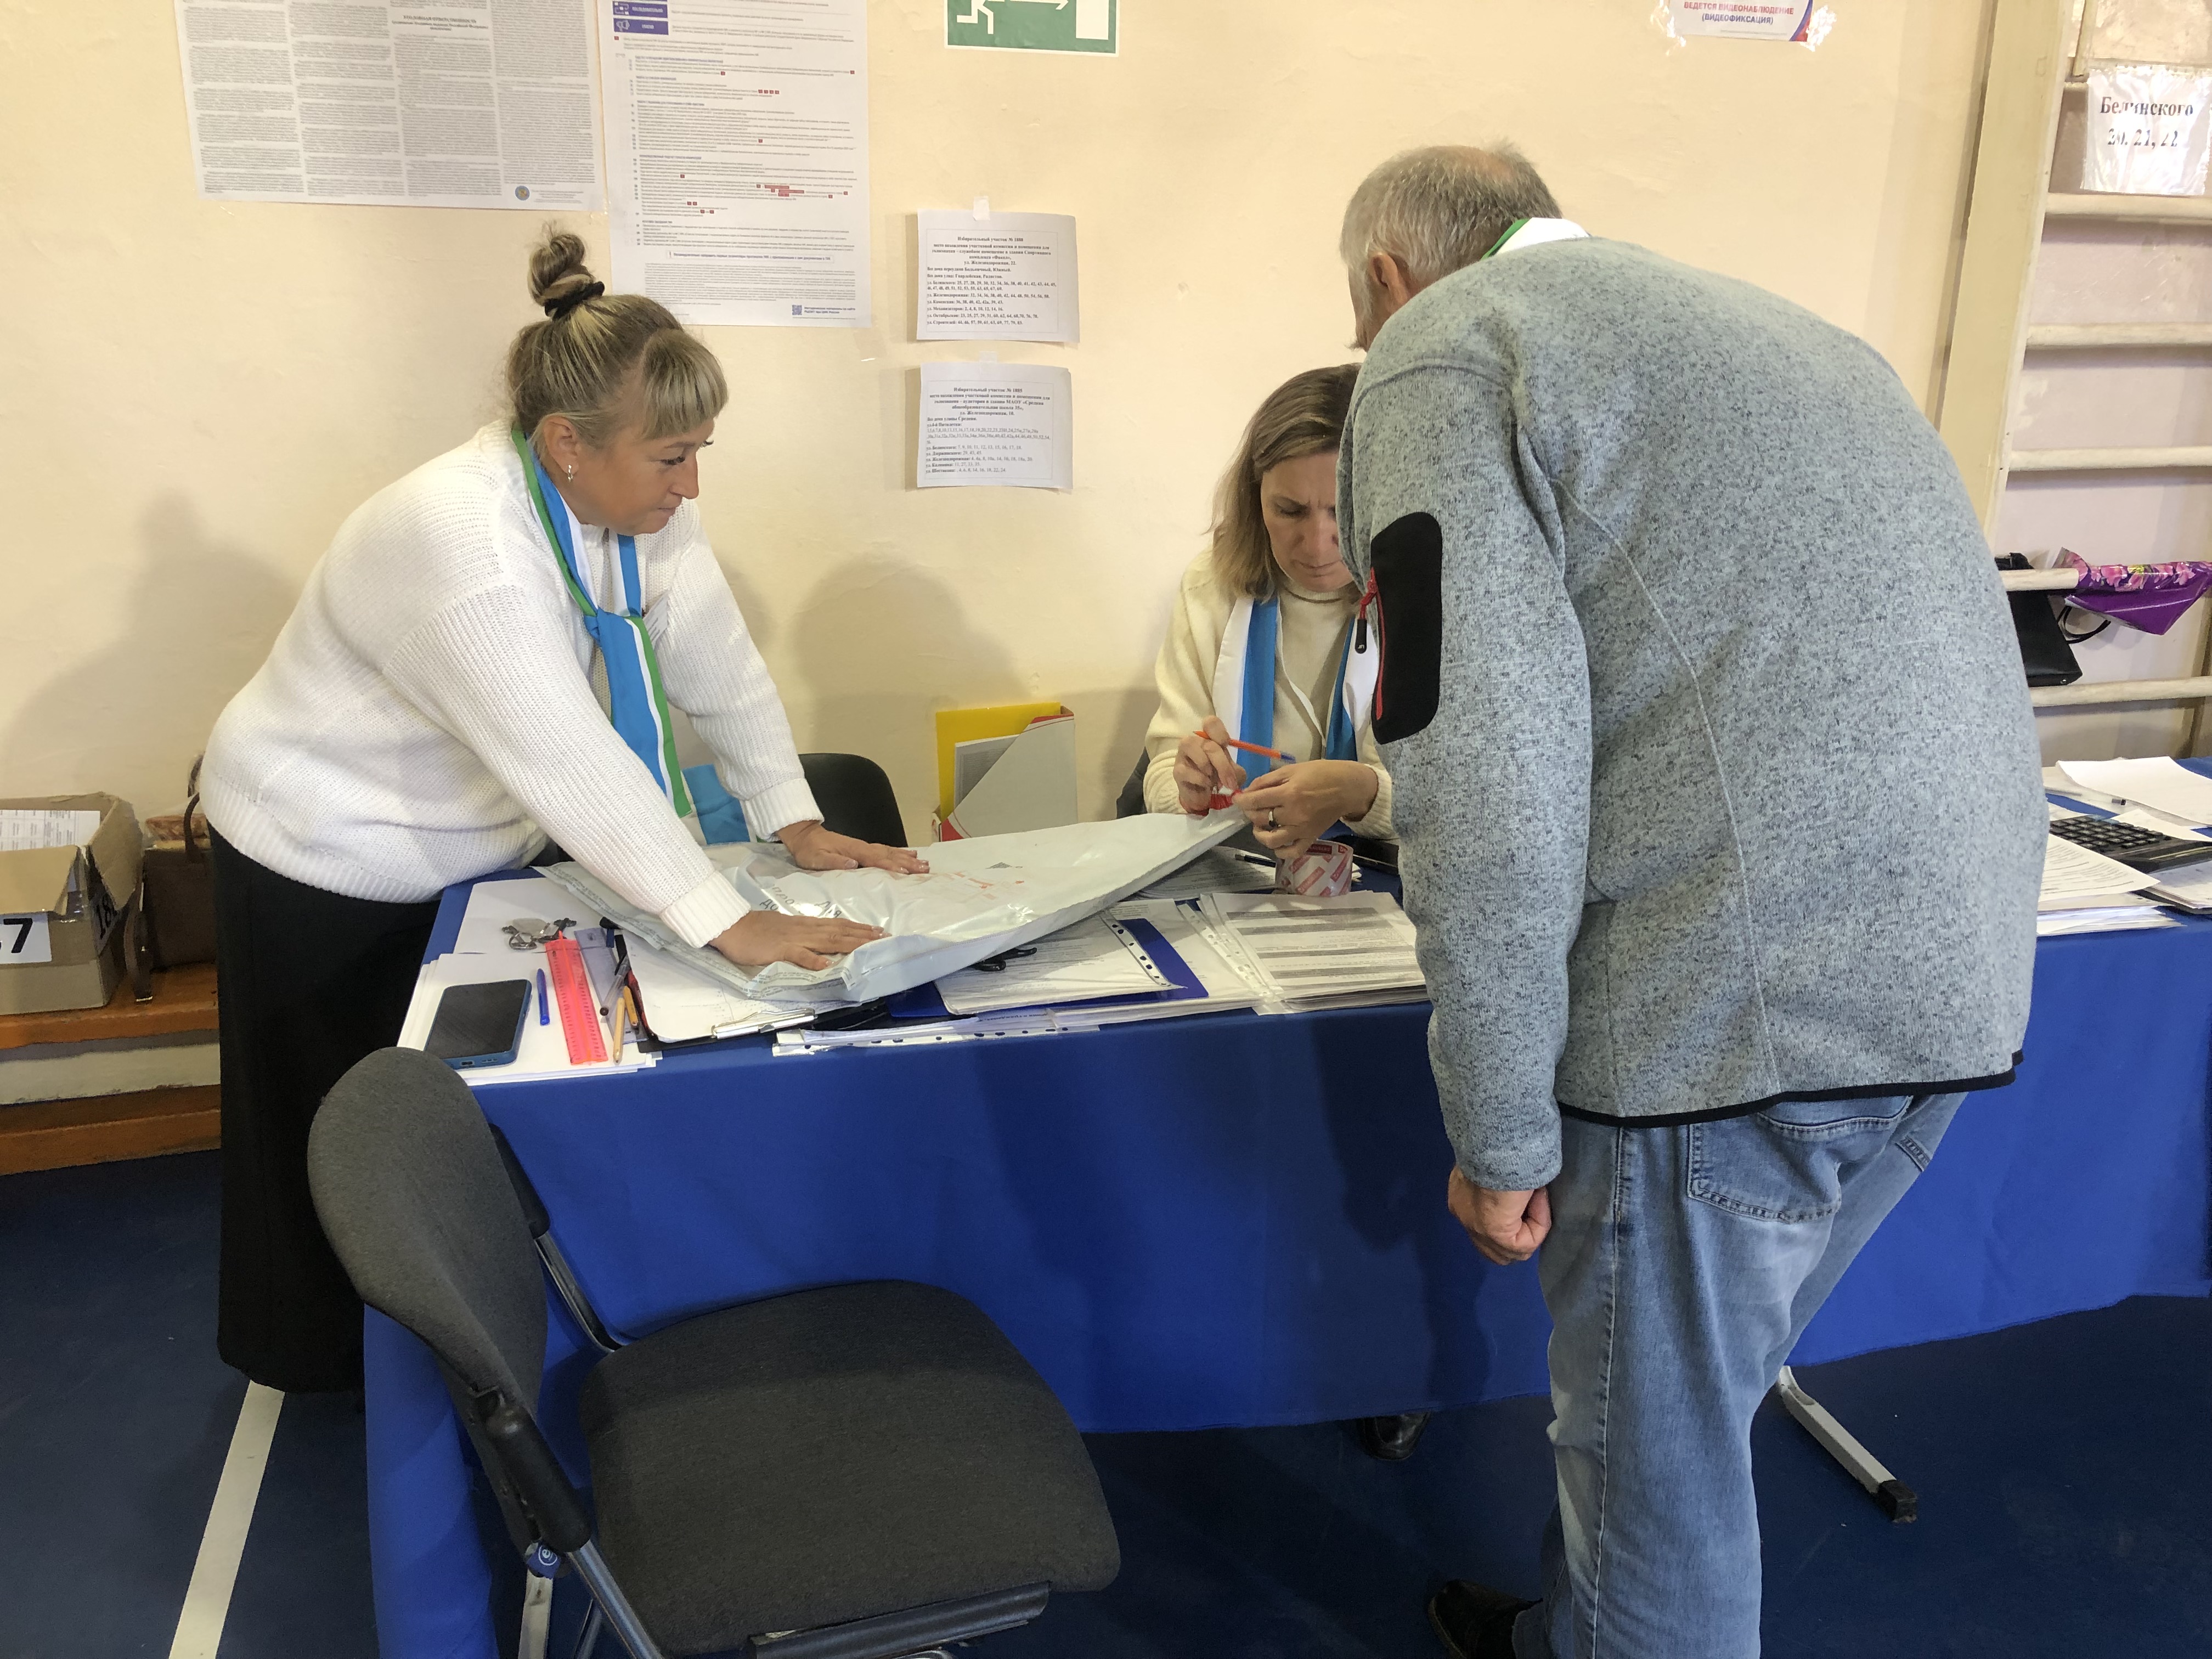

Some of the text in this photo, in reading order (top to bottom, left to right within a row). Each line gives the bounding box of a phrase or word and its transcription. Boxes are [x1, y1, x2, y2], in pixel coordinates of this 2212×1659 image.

[1719, 3, 1794, 15] ВИДЕОНАБЛЮДЕНИЕ
[1702, 13, 1774, 25] (ВИДЕОФИКСАЦИЯ)
[759, 899, 779, 911] ДО
[0, 918, 33, 953] 7
